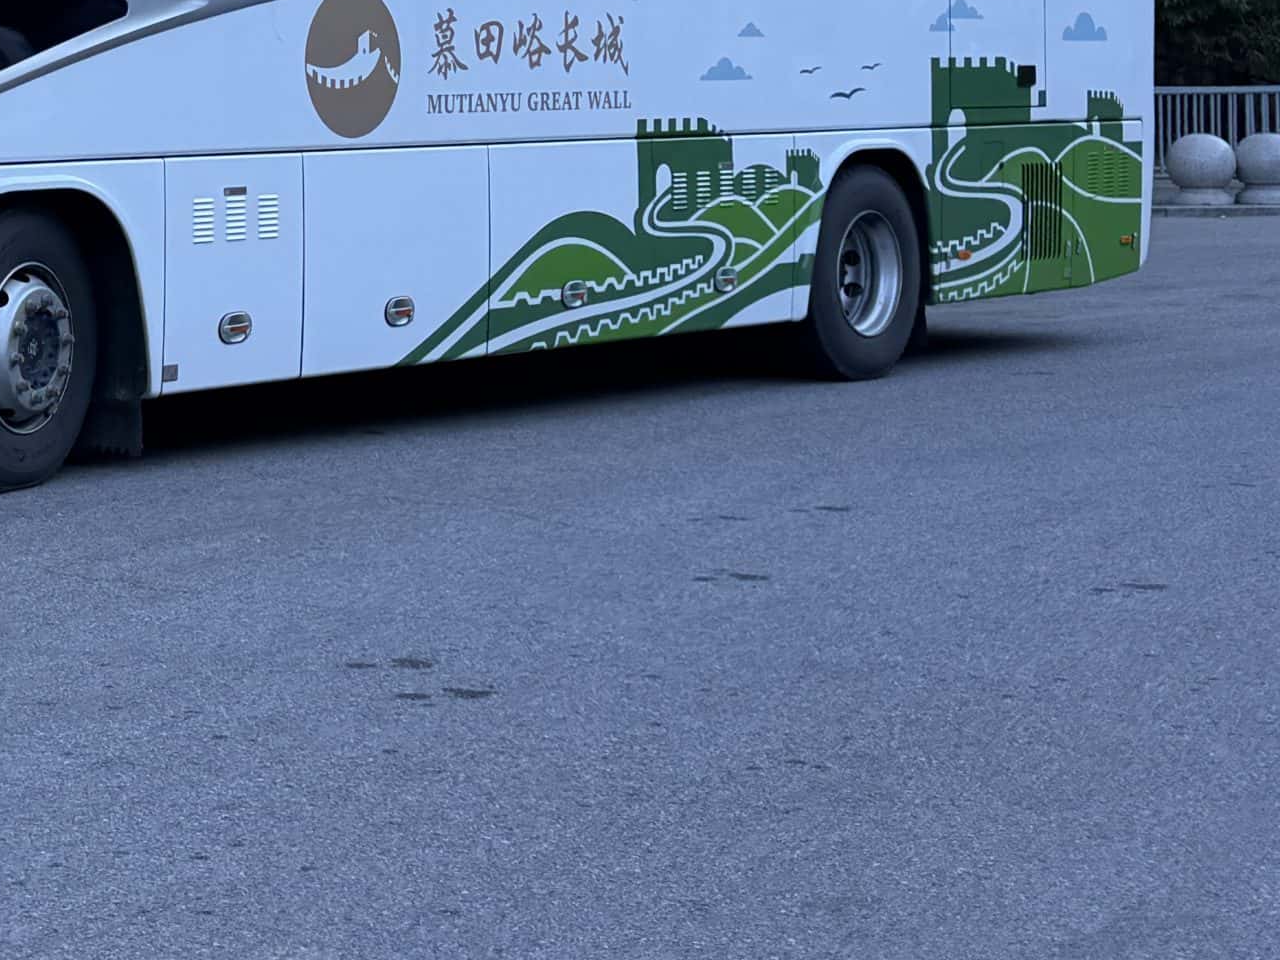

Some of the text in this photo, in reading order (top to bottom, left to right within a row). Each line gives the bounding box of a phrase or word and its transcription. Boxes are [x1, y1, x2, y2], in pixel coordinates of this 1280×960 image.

[427, 8, 629, 80] 慕田峪长城
[426, 90, 631, 114] MUTIANYU GREAT WALL
